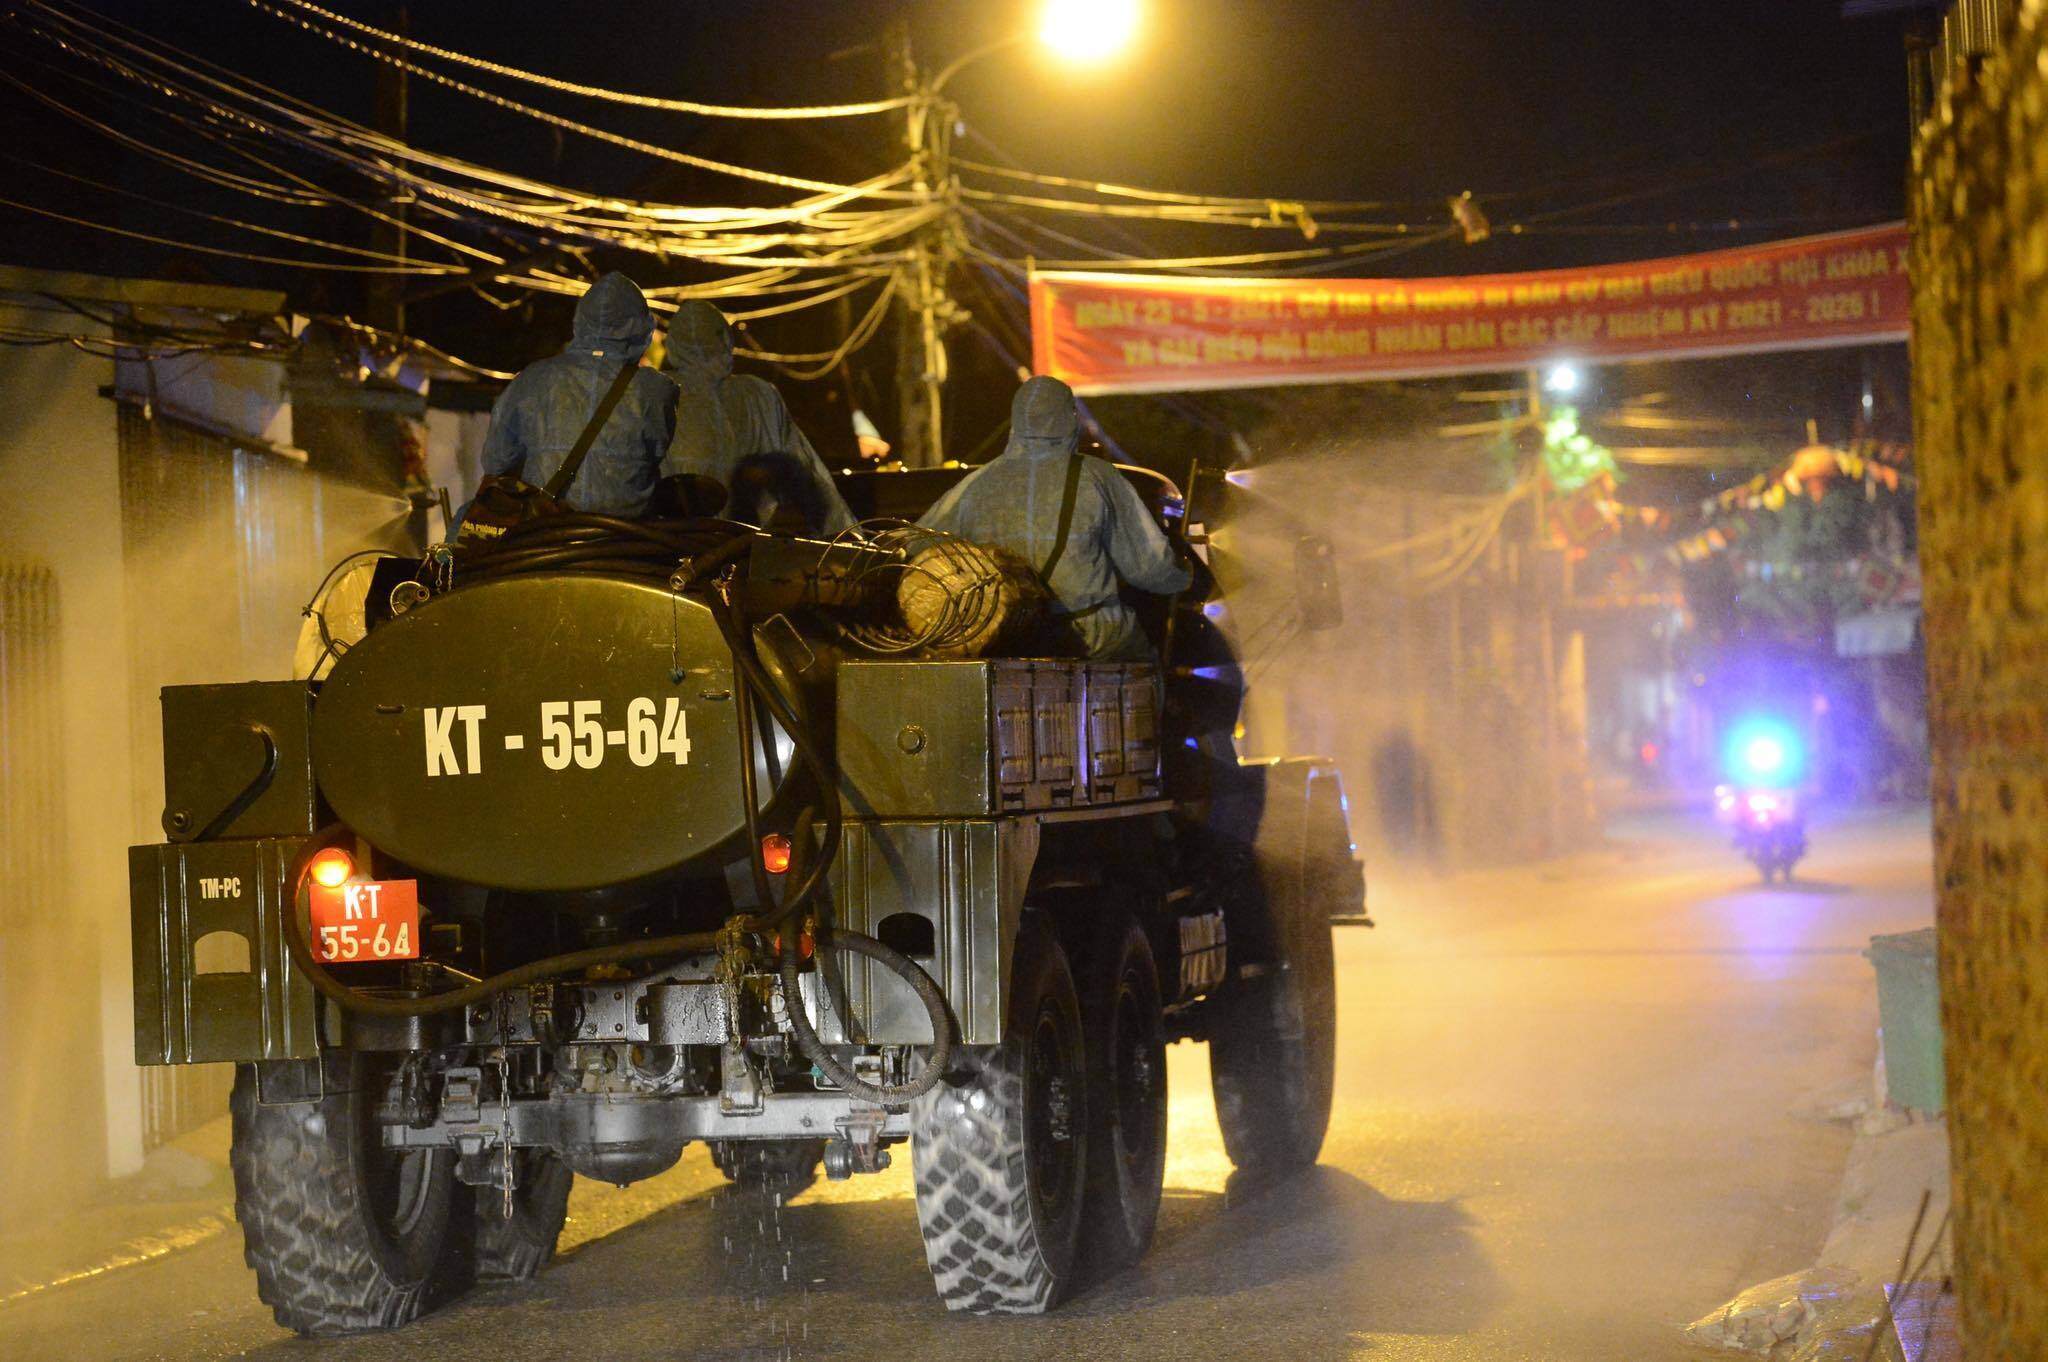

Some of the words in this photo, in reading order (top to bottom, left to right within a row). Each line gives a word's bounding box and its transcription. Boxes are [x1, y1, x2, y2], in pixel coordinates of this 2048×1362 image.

[1144, 299, 1172, 325] 23
[423, 704, 487, 777] KT
[504, 734, 524, 750] -
[541, 696, 691, 770] 55-64
[199, 876, 241, 900] TM-PC
[319, 921, 411, 961] 55-64
